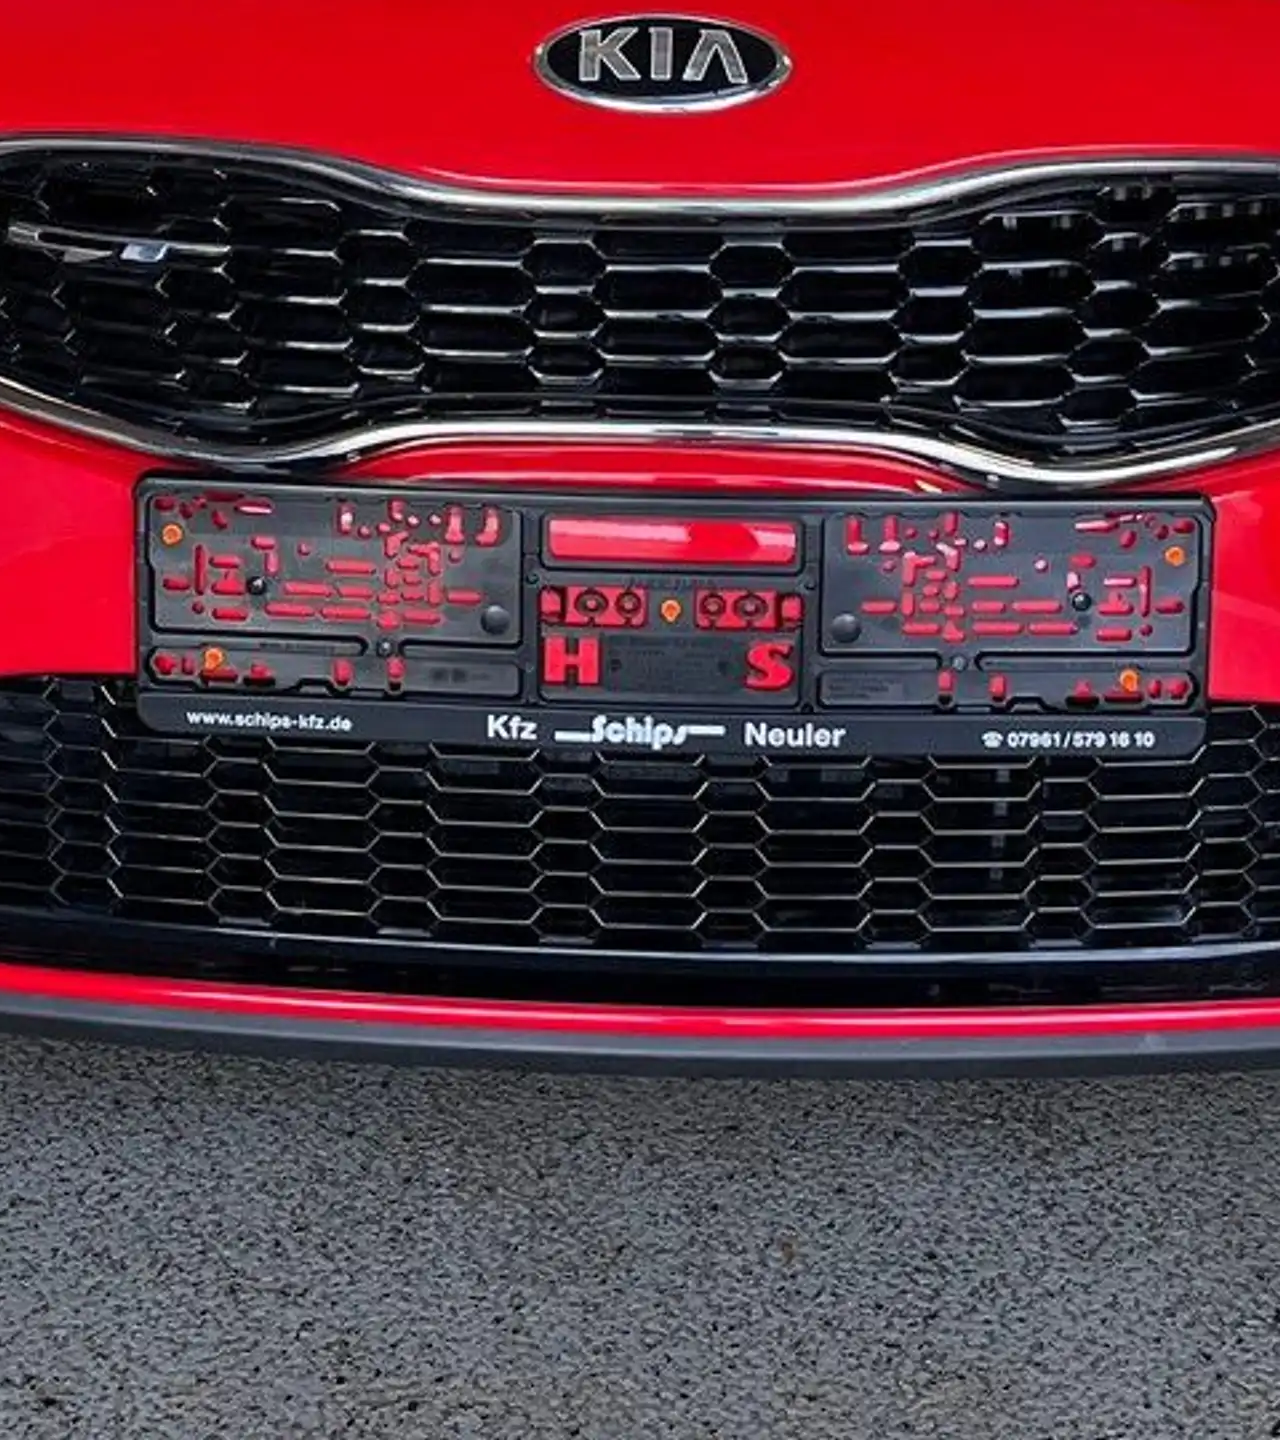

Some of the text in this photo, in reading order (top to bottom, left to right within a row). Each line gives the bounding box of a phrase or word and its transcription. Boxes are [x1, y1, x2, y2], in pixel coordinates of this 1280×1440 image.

[578, 26, 748, 84] KIA
[186, 710, 353, 732] www.schips-kfz.de
[486, 714, 538, 741] Kfz
[743, 721, 846, 748] Neuler
[1133, 731, 1156, 748] 10
